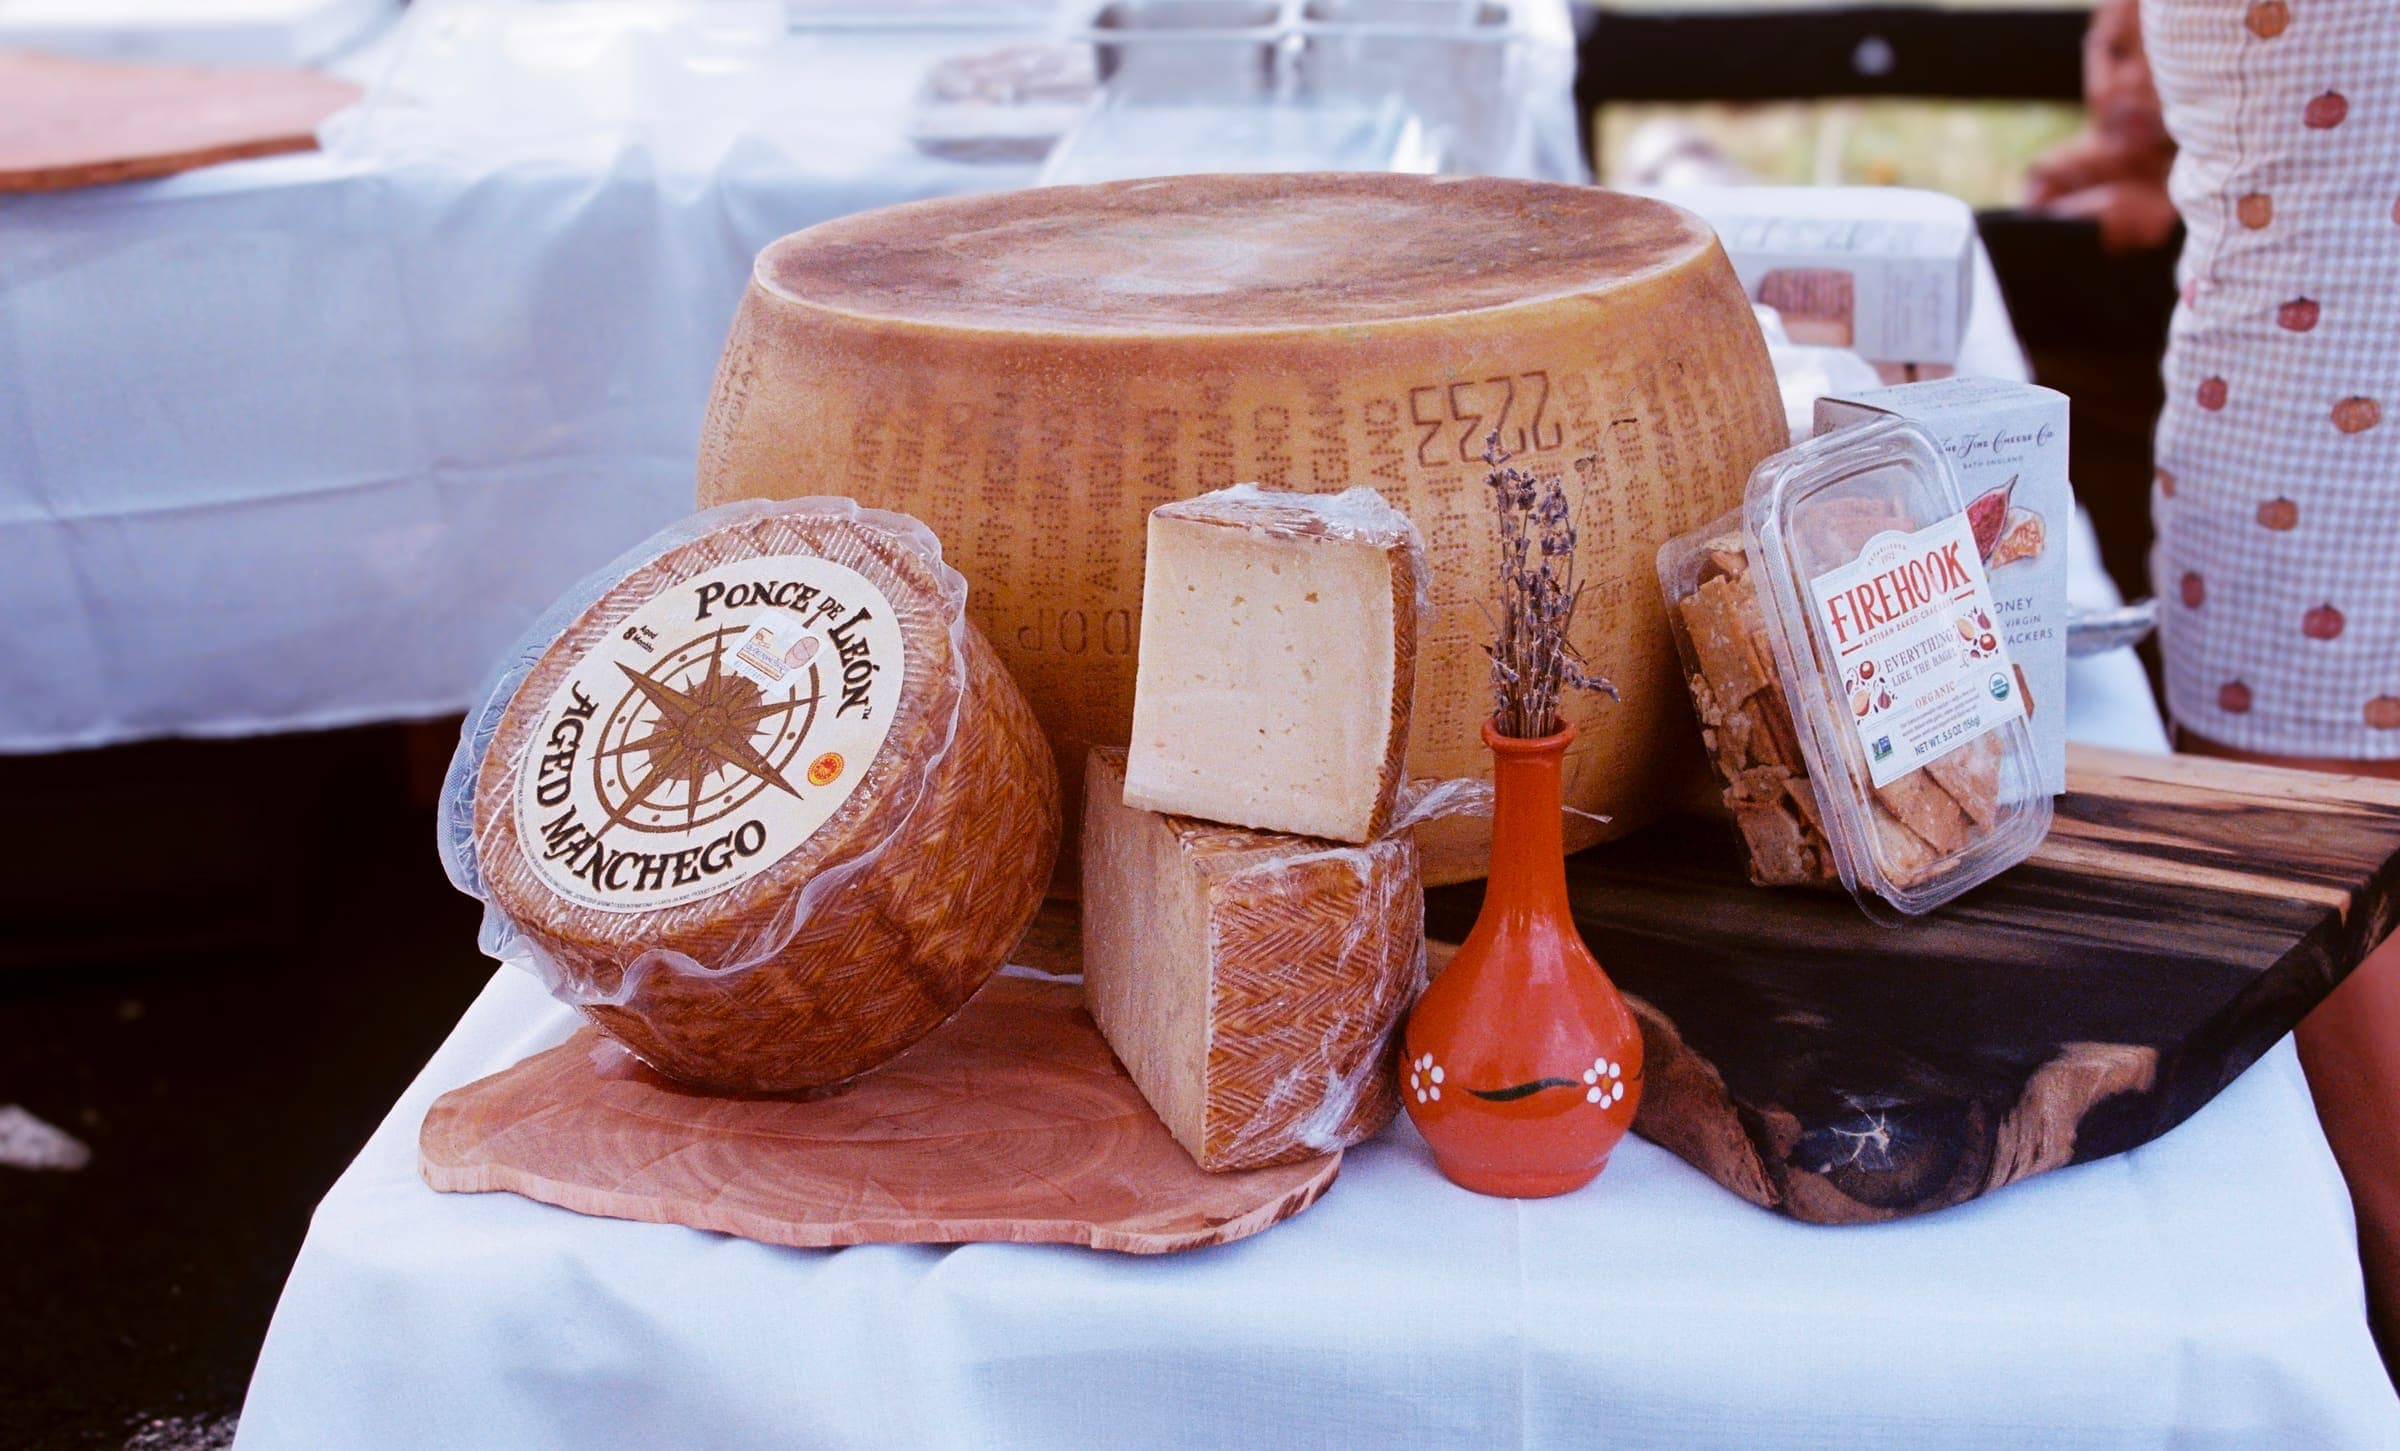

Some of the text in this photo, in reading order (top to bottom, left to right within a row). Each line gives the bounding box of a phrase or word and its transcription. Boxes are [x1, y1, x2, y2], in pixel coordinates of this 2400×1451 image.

[694, 580, 821, 621] PONCE
[1827, 540, 1972, 644] FIREHOOK
[1994, 597, 2034, 614] ONEY
[2004, 614, 2042, 628] VIRGIN
[1885, 629, 1954, 673] EVERYTHING
[2007, 629, 2054, 646] ACKERS
[1914, 660, 1933, 681] THE
[1915, 681, 1956, 709] ORGANIC
[537, 680, 599, 808] AGED
[1914, 737, 1932, 756] NET
[540, 804, 767, 893] MANCHEGO
